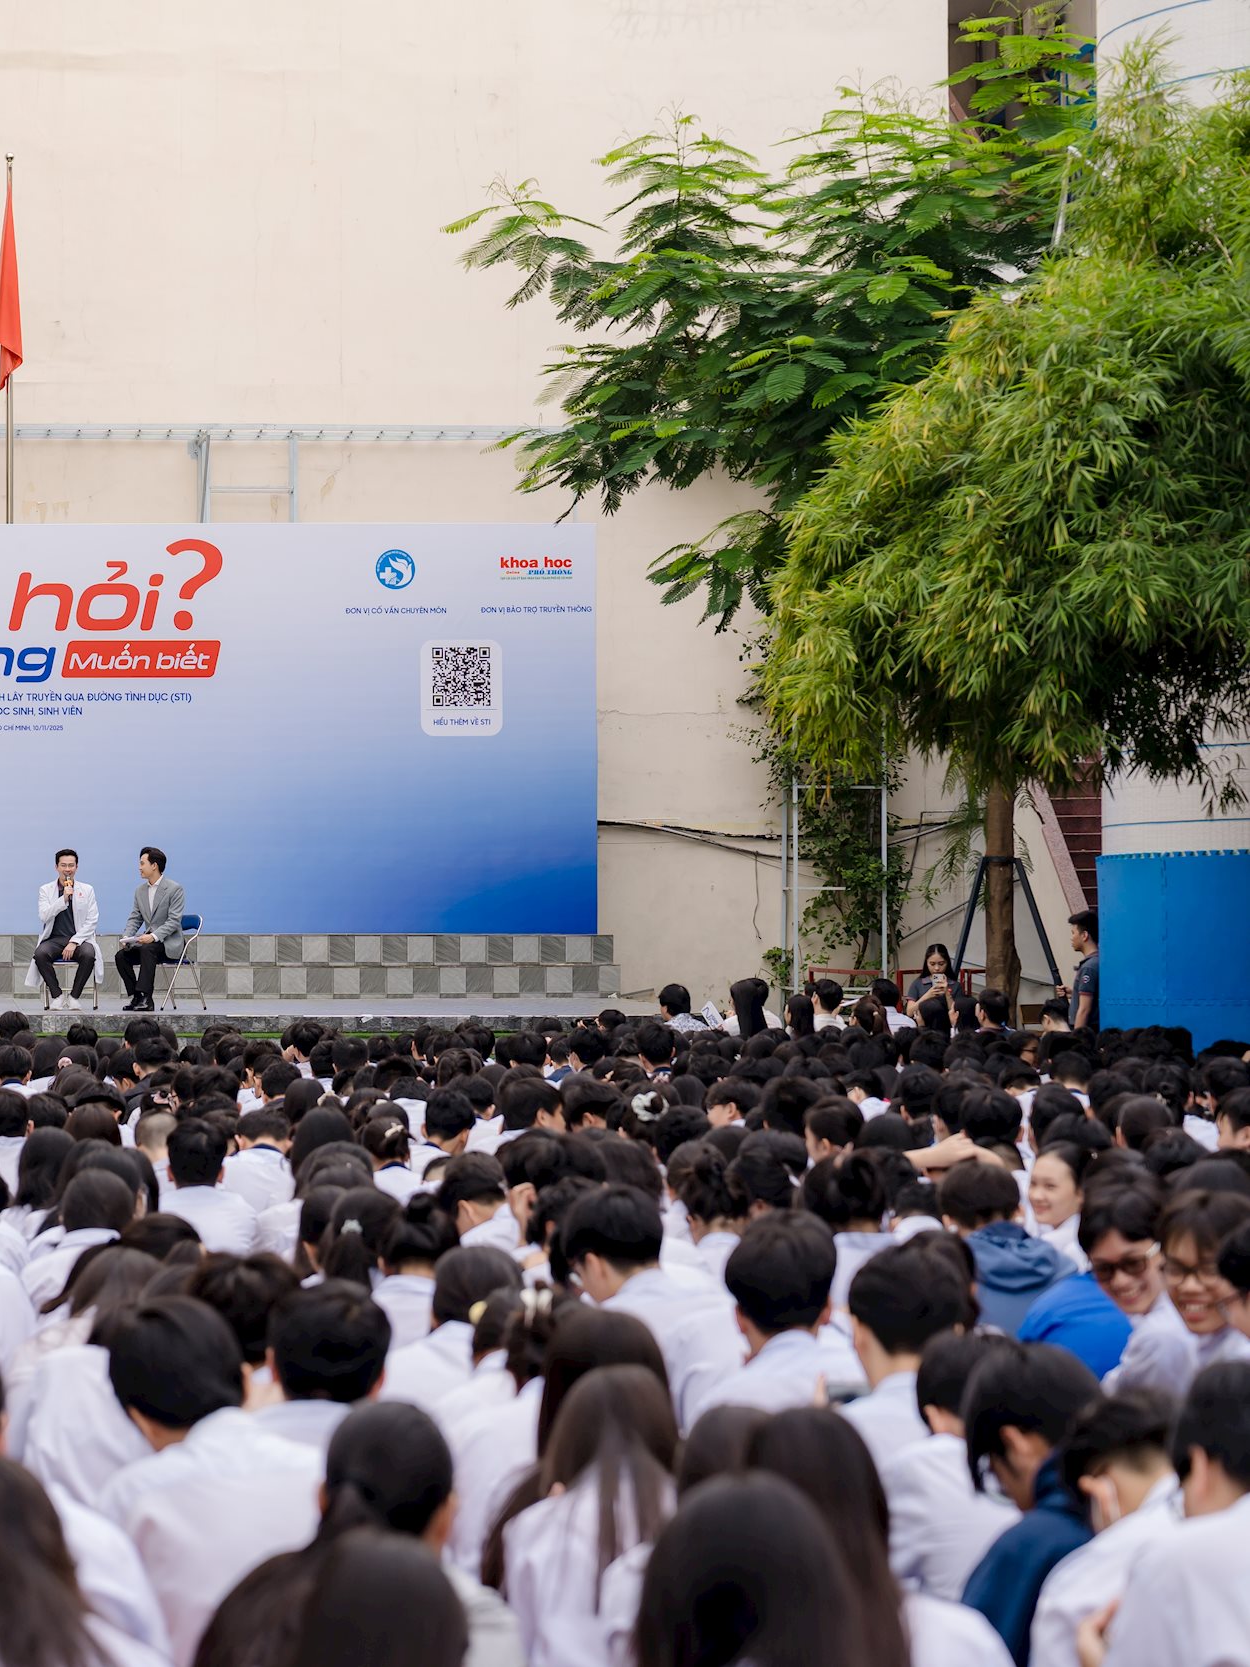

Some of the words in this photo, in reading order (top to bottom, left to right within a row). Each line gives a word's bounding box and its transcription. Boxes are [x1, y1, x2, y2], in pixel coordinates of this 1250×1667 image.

[500, 556, 539, 569] khoa
[8, 538, 224, 632] hỏi?
[345, 607, 362, 615] ĐƠN
[363, 607, 370, 616] VỊ
[370, 605, 383, 615] CỐ
[384, 605, 400, 615] VẤN
[400, 606, 429, 615] CHUYÊN
[429, 606, 447, 615] MÔN
[480, 606, 497, 614] ĐƠN
[498, 606, 506, 615] VỊ
[523, 605, 538, 615] TRỢ
[539, 604, 566, 614] TRUYỀN
[566, 604, 593, 614] THÔNG
[68, 643, 152, 671] Muốn
[155, 643, 212, 671] biết
[7, 690, 24, 701] LÂY
[26, 689, 62, 701] TRUYỀN
[63, 692, 85, 702] QUA
[86, 690, 123, 701] ĐƯỜNG
[124, 690, 146, 701] TÌNH
[148, 692, 169, 703] DỤC
[170, 691, 193, 703] (STI)
[12, 707, 37, 717] SINH,
[38, 707, 60, 716] SINH
[61, 705, 83, 716] VIÊN
[433, 716, 449, 726] HIỂU
[449, 717, 469, 726] THÊM
[469, 715, 480, 726] VỀ
[480, 718, 491, 726] STI
